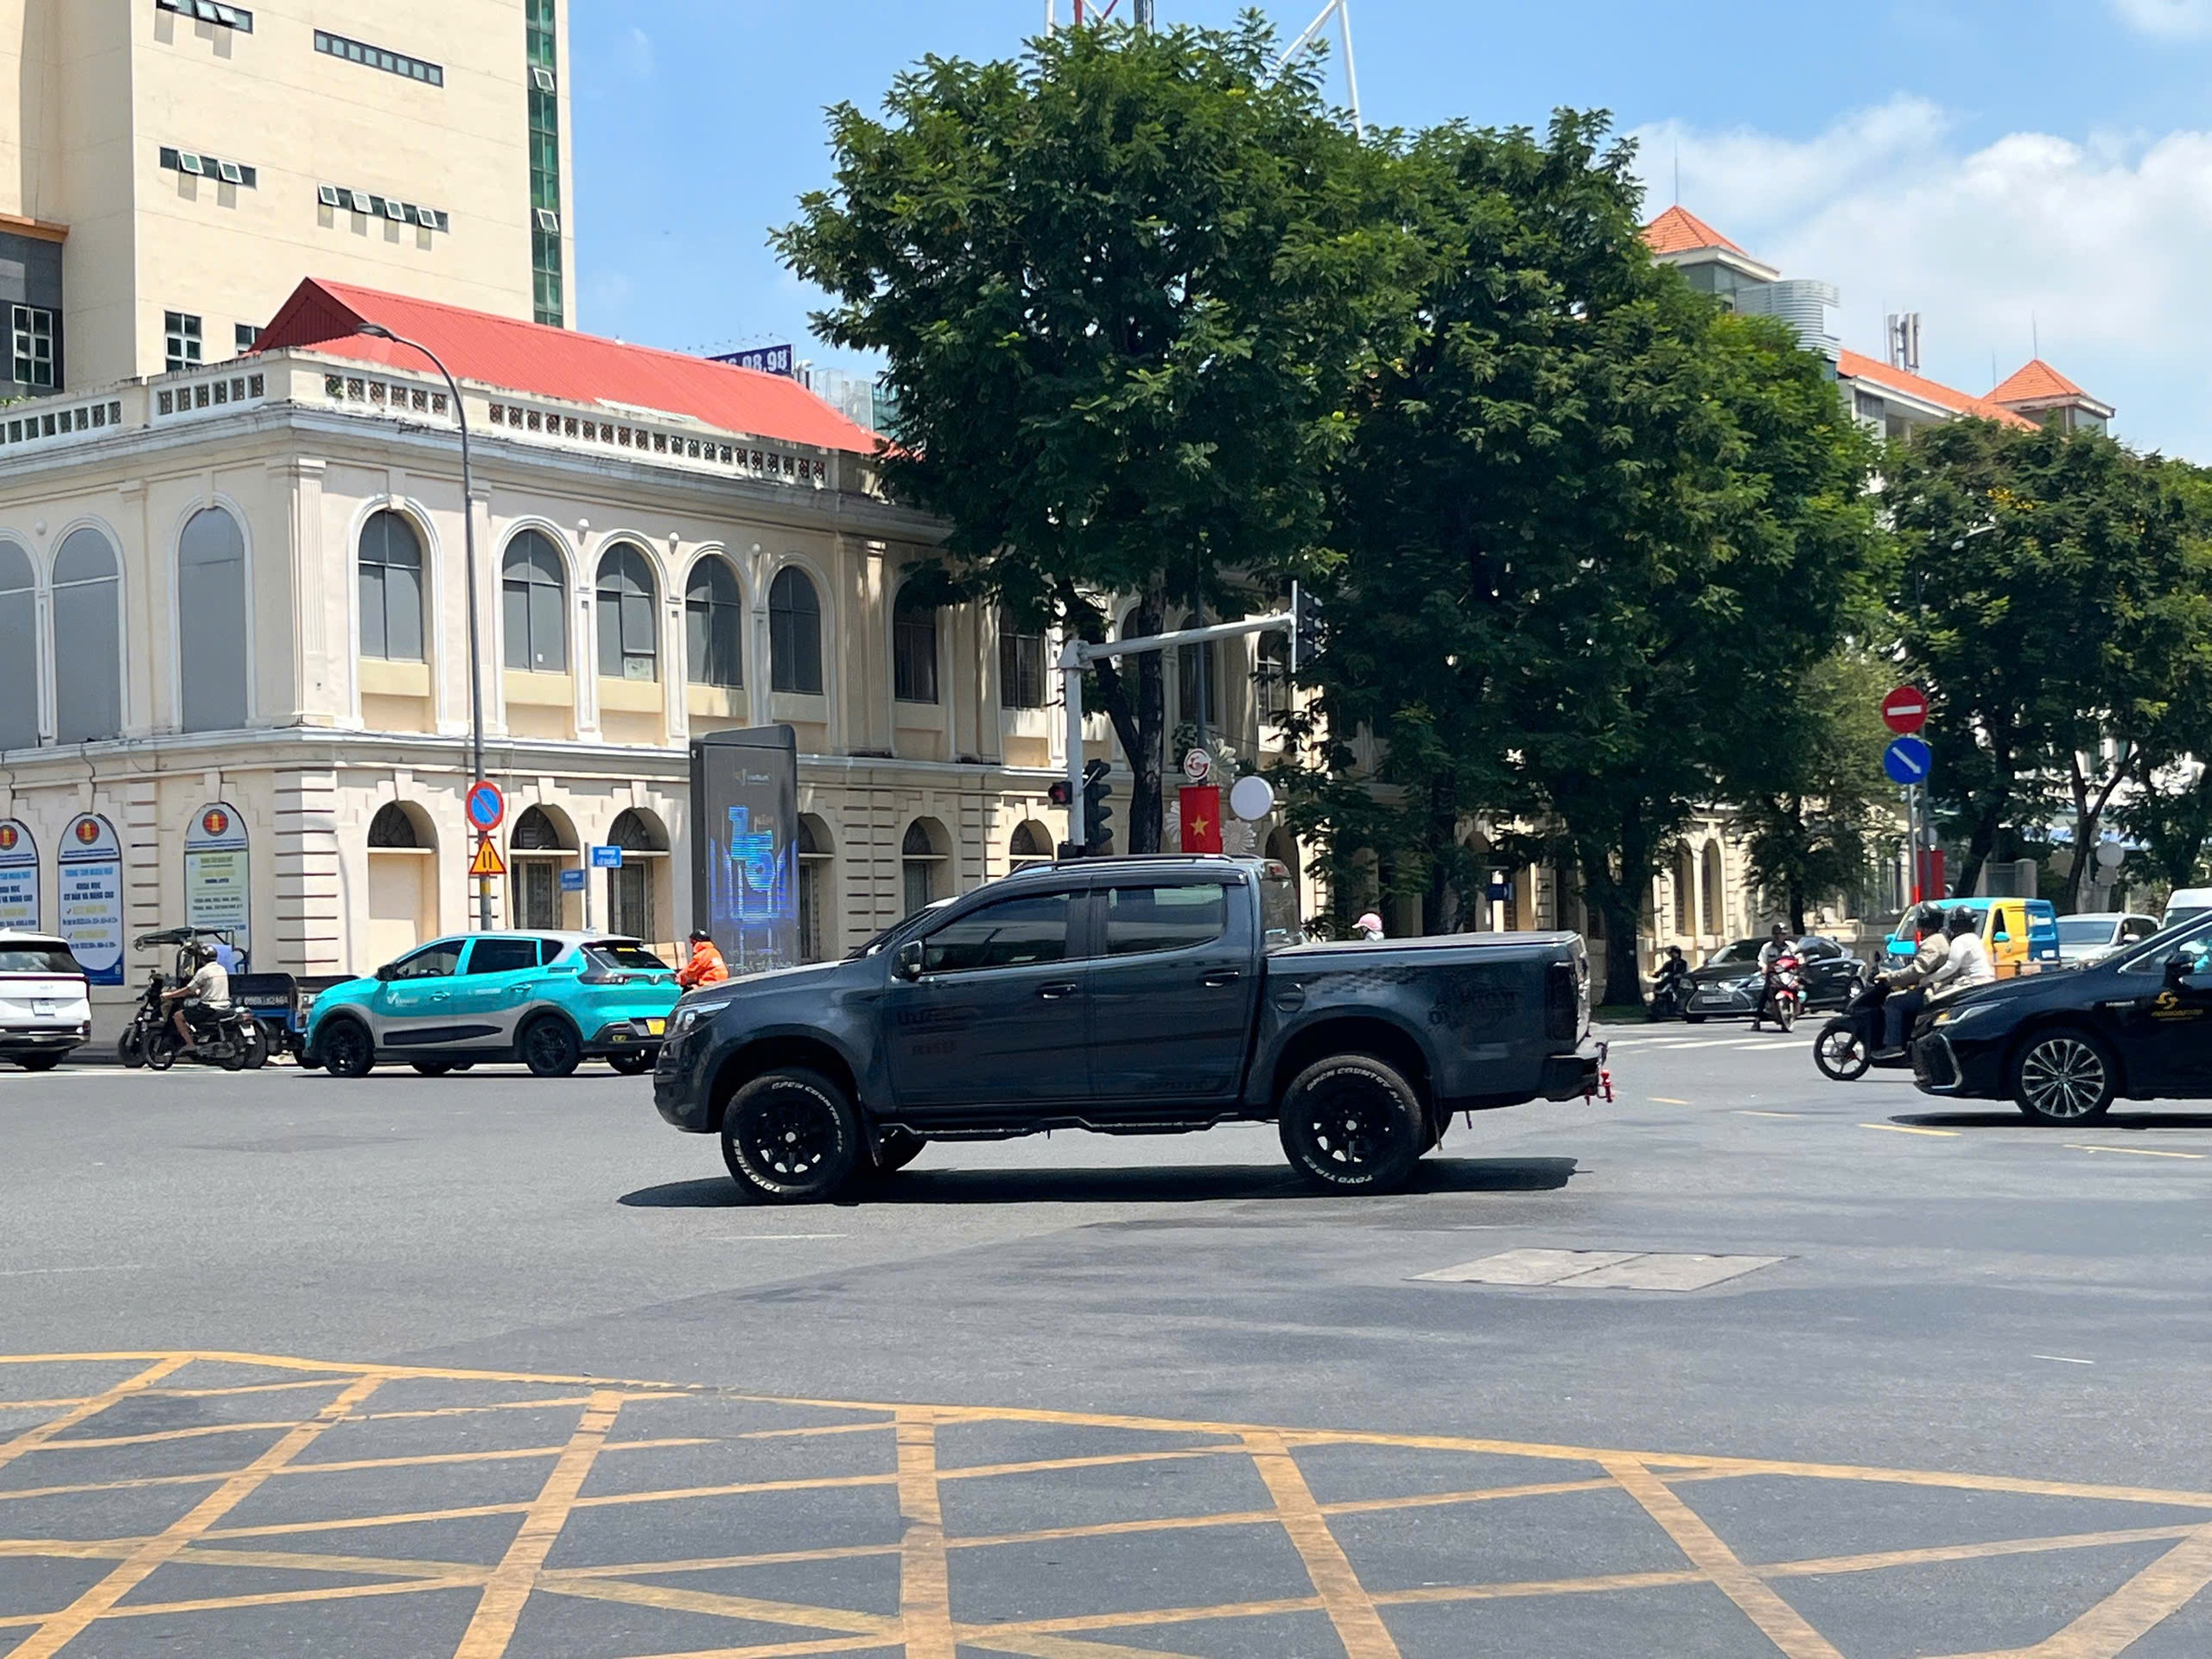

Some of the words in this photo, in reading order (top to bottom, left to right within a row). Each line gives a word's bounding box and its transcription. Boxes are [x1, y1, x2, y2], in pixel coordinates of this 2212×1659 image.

[1306, 1070, 1335, 1091] OPEN
[1337, 1067, 1392, 1088] COUNTRY
[772, 1081, 804, 1090] OPEN
[804, 1086, 841, 1126] COUNTRY
[749, 1174, 781, 1192] TOYO
[1338, 1174, 1374, 1184] TOYO
